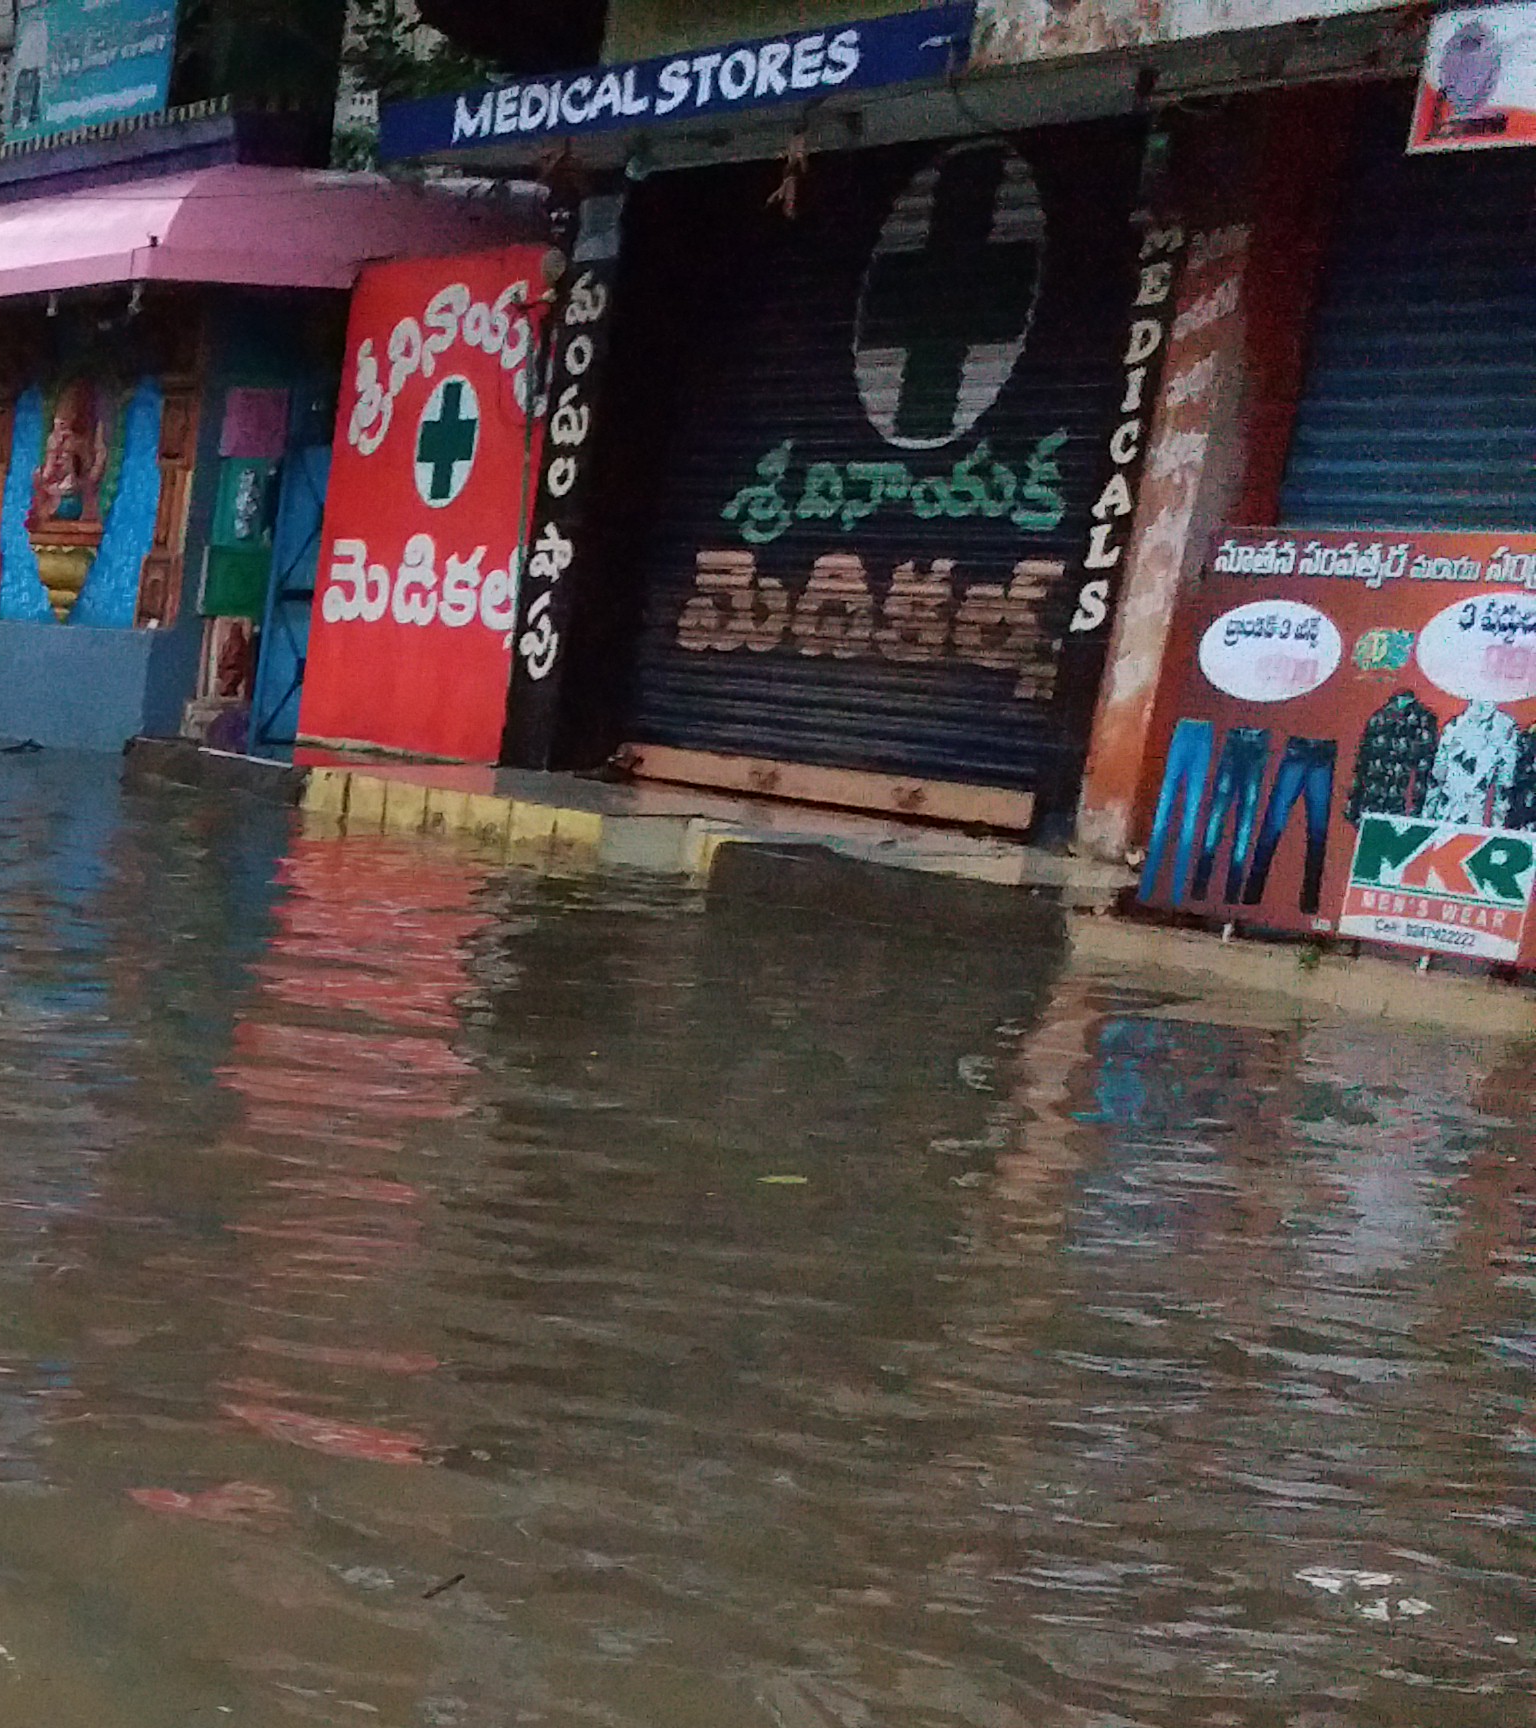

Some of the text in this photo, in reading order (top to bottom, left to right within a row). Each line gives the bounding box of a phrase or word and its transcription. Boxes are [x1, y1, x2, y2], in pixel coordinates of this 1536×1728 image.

[451, 29, 860, 144] MEDICAL STORES
[1069, 224, 1186, 633] MEDICALS
[1351, 818, 1536, 901] MKR
[1361, 890, 1506, 928] MEN'S WEAR
